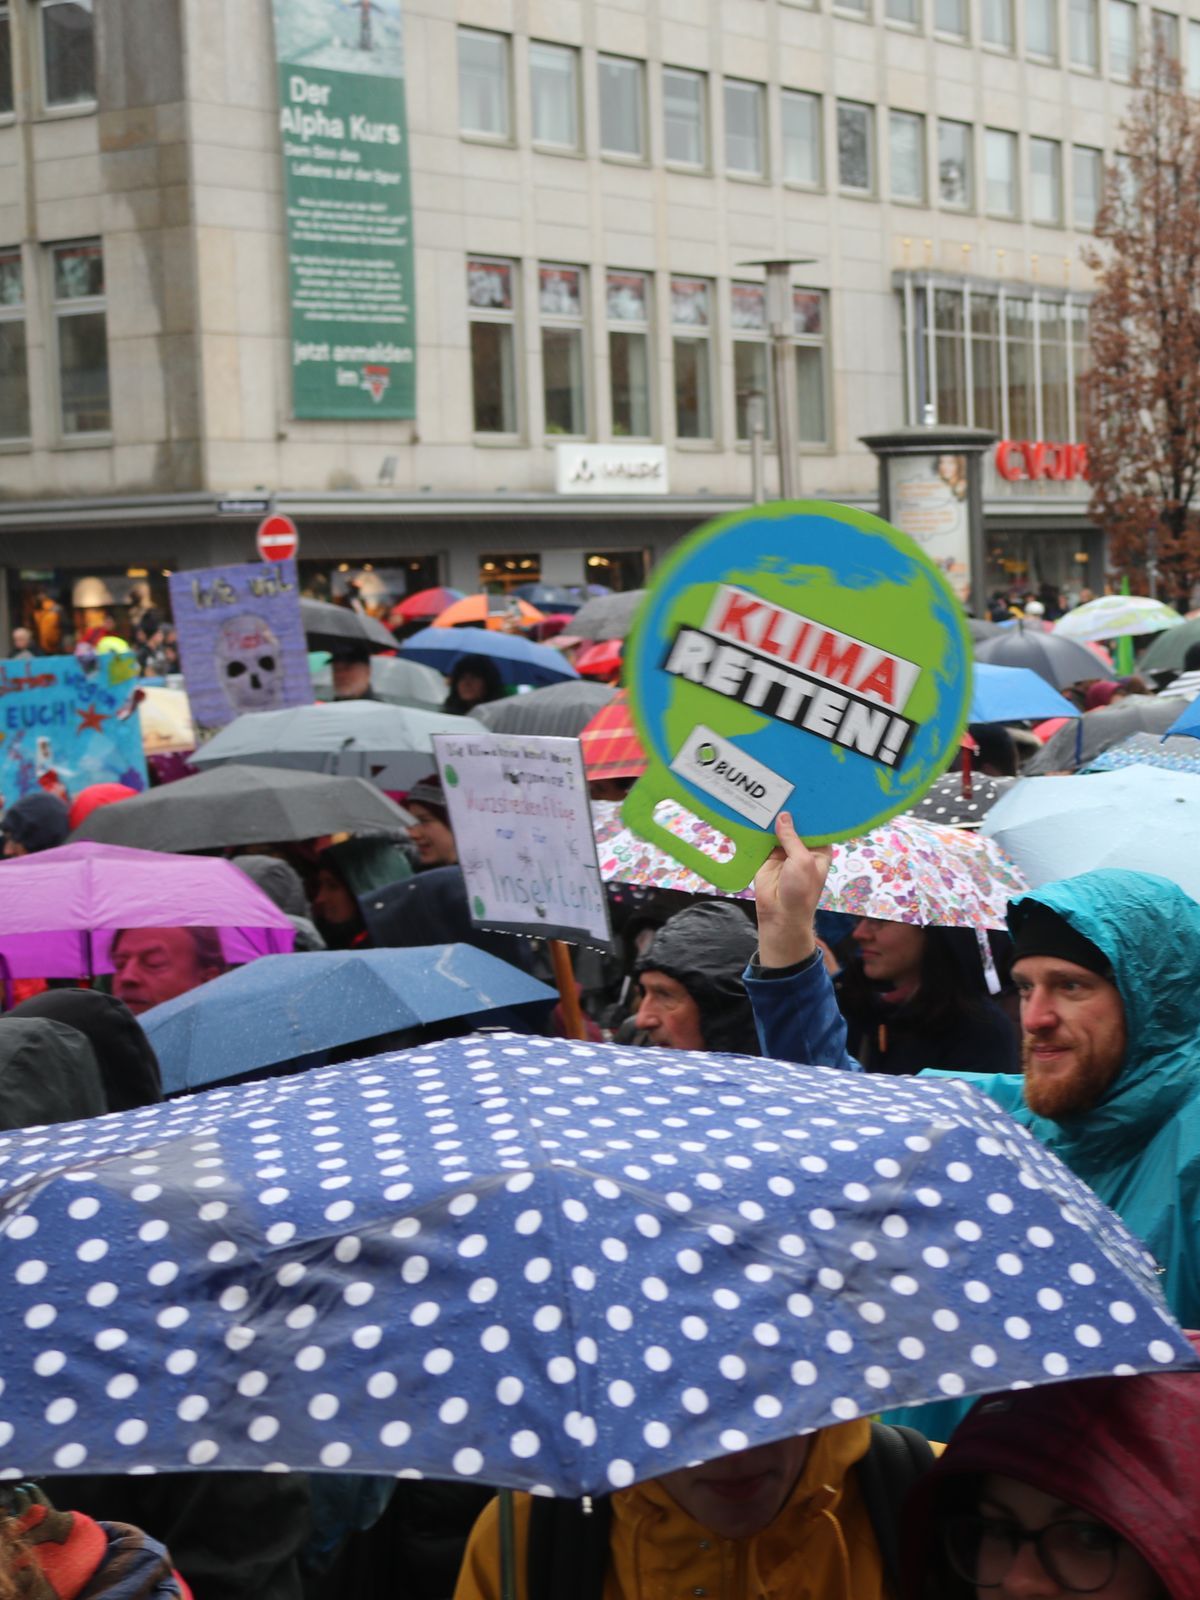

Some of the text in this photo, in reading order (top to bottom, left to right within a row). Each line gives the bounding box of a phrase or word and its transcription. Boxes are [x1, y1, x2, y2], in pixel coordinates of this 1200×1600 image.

[289, 75, 331, 105] Der
[280, 106, 401, 145] Alpha Kurs
[293, 341, 413, 366] jetzt anmelden
[336, 367, 359, 387] im
[718, 593, 898, 706] KLIMA
[664, 630, 910, 765] RETTEN!
[714, 760, 767, 799] BUND
